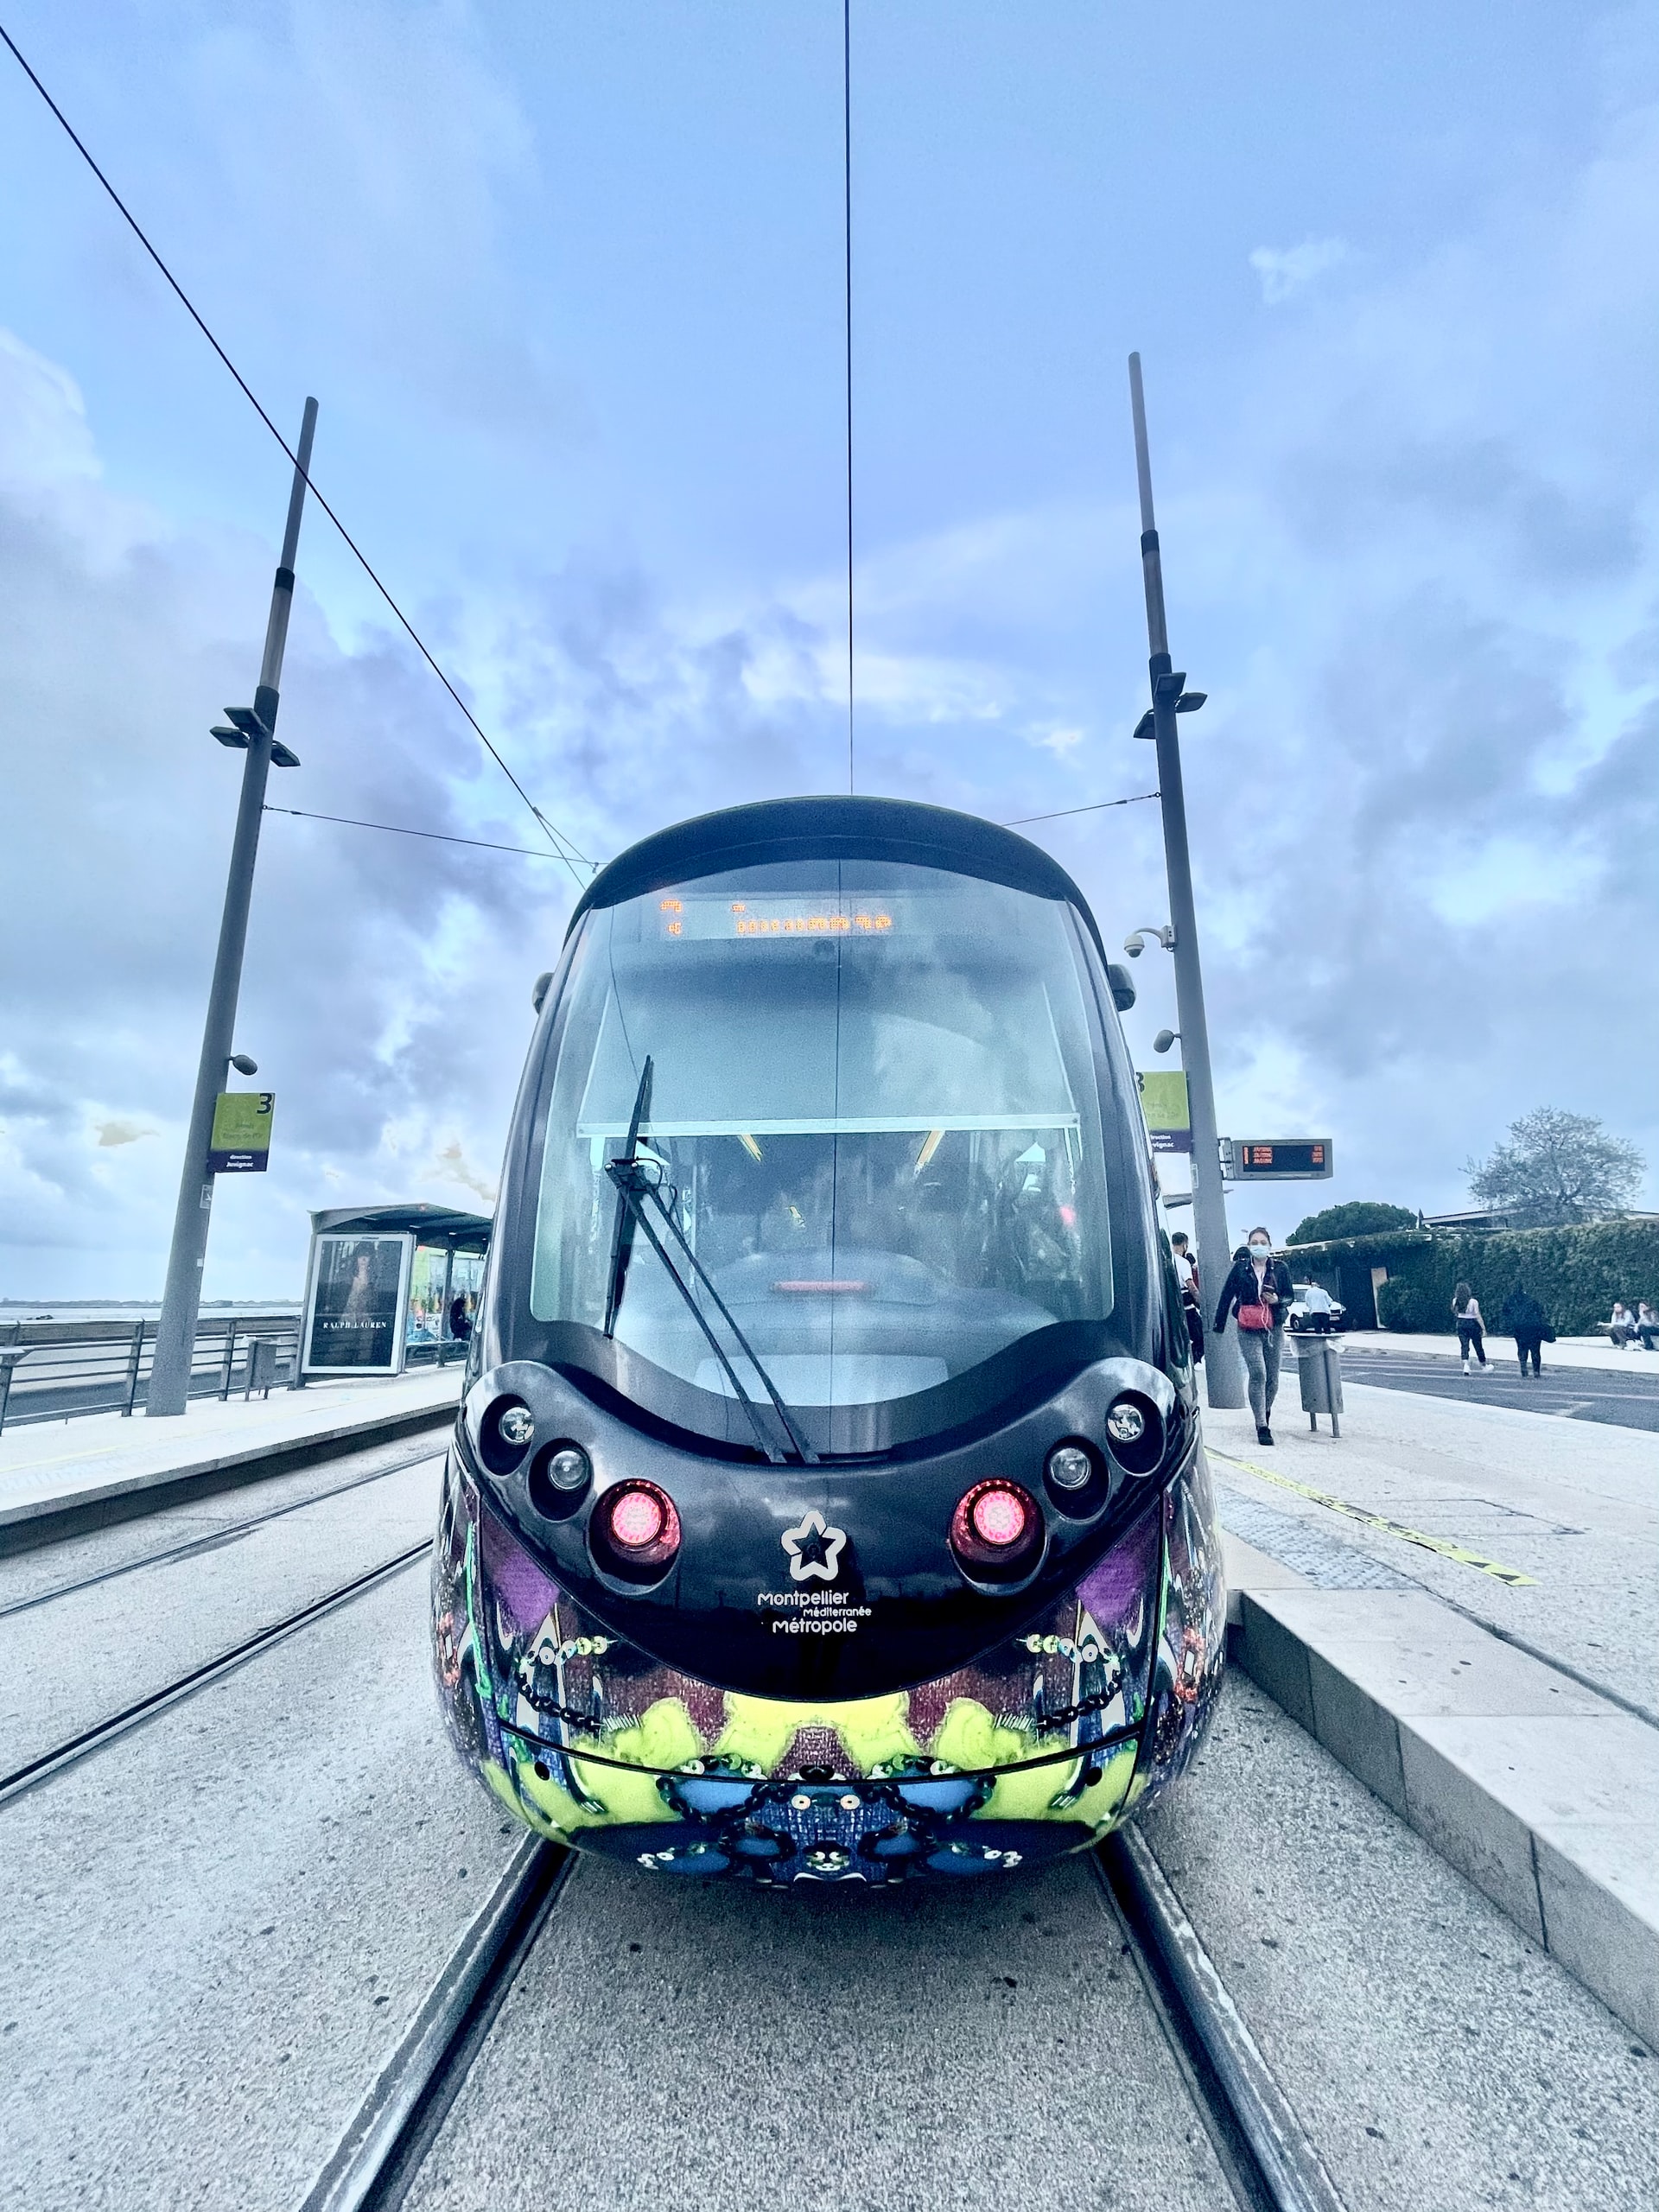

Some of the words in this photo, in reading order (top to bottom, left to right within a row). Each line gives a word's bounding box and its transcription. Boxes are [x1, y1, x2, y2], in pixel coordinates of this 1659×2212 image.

[257, 1093, 272, 1114] 3
[351, 1320, 387, 1329] LAUREN
[757, 1590, 849, 1608] Montpellier
[803, 1605, 872, 1618] Méditerranée
[772, 1617, 858, 1636] Métropole
